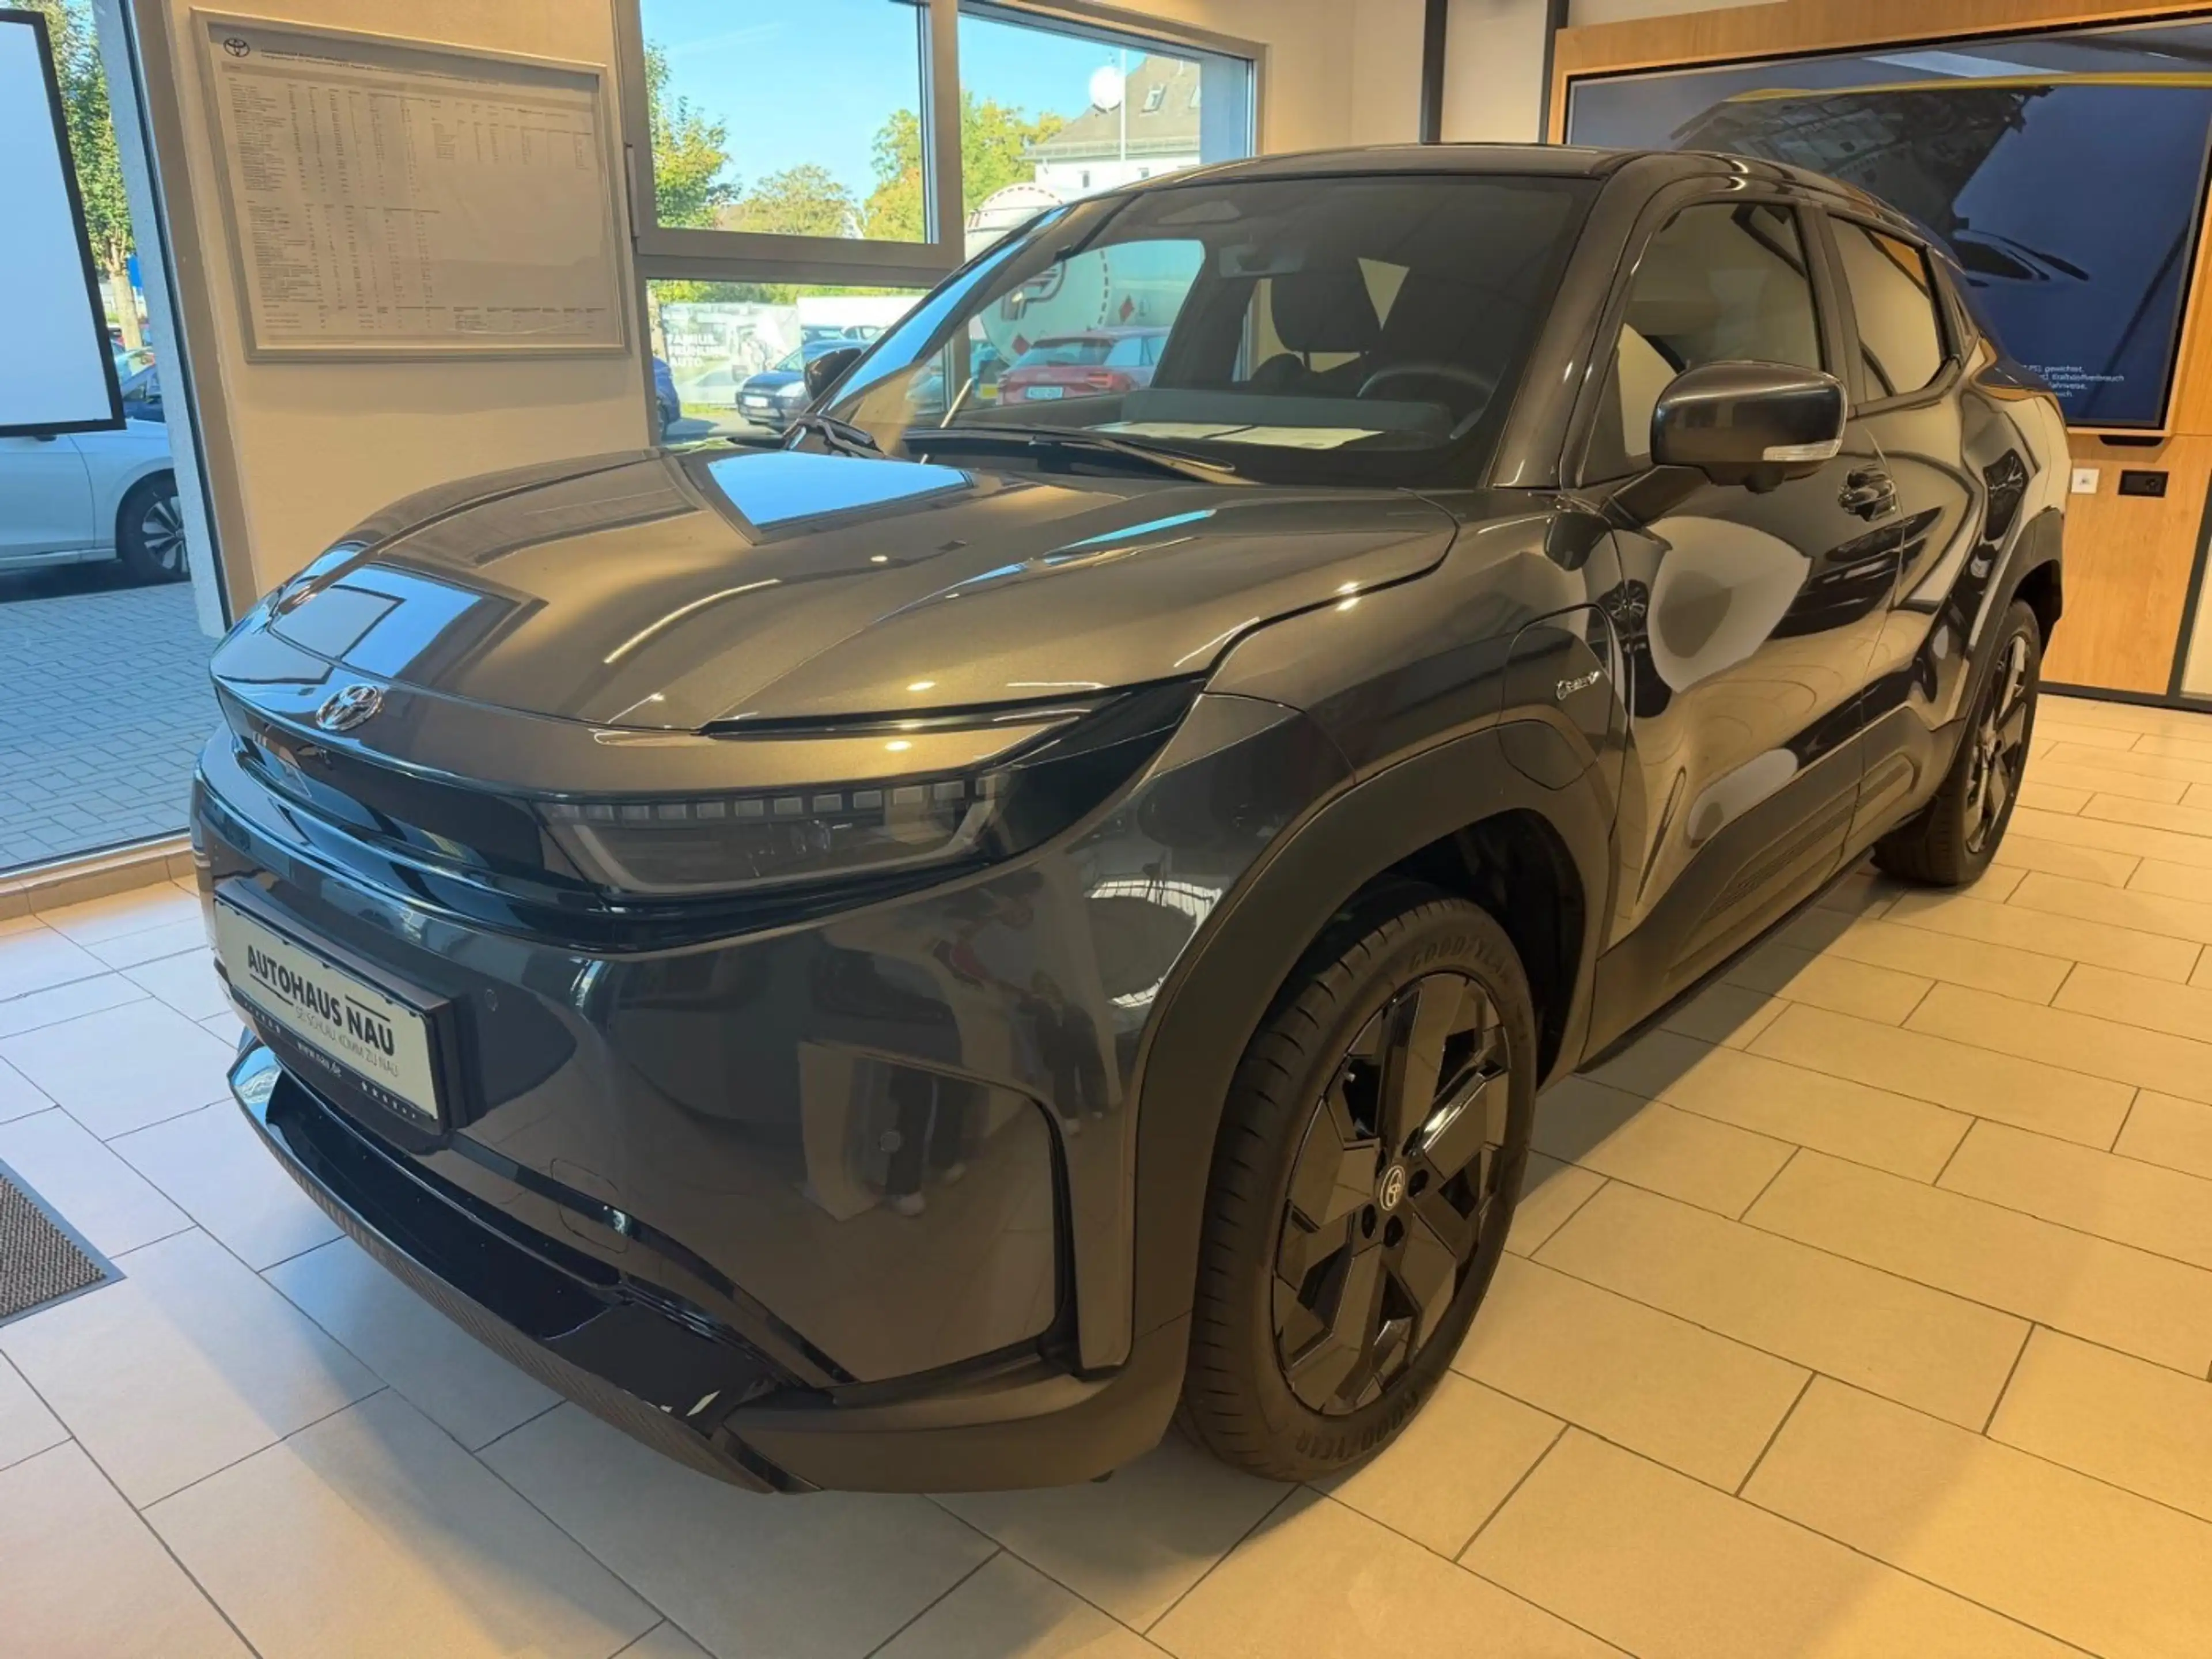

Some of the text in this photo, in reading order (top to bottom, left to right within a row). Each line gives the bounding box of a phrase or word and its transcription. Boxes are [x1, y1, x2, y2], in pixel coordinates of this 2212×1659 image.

[2052, 373, 2124, 382] Kraftstoffverbrauch
[248, 944, 395, 1056] AUTOHAUS NAU
